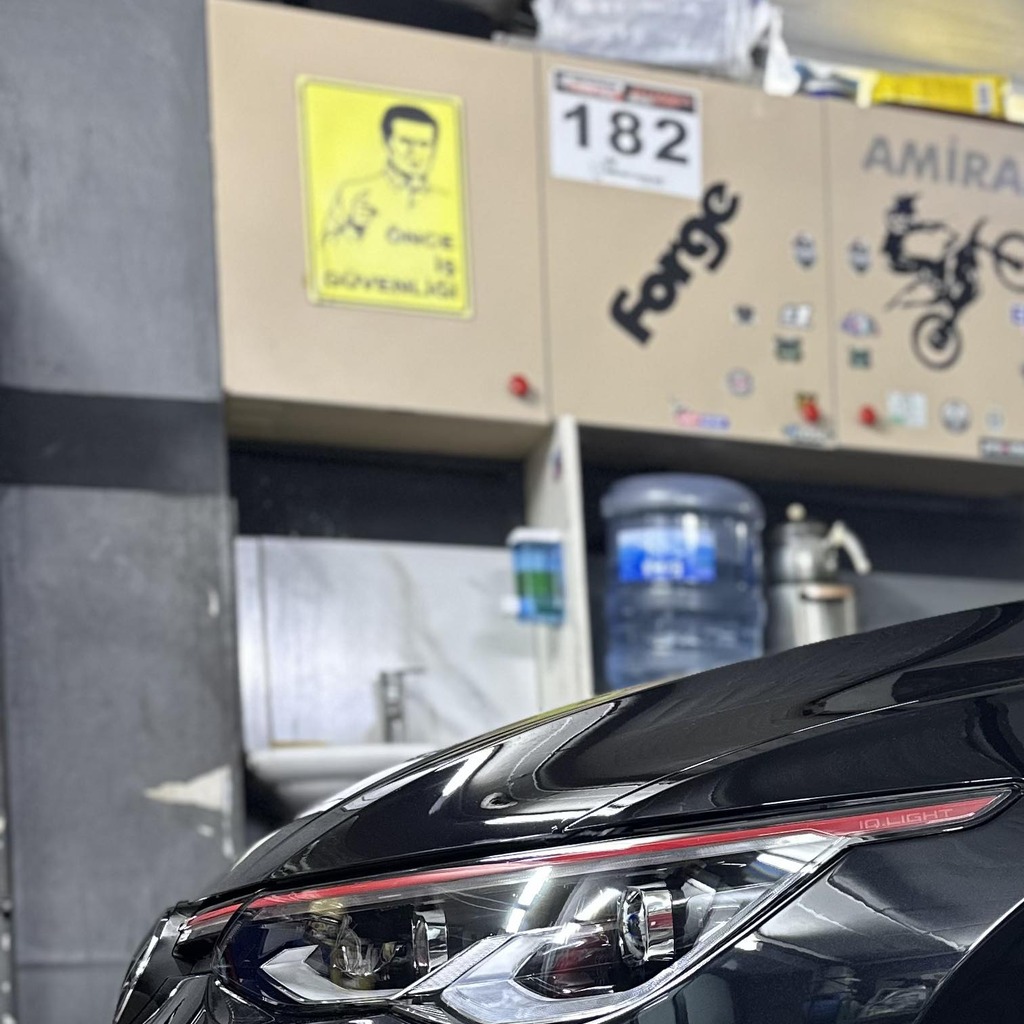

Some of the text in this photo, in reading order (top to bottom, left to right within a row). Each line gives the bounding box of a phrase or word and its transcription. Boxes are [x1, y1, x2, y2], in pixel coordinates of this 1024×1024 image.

[564, 102, 688, 164] 182
[609, 181, 741, 345] forge
[859, 808, 953, 829] IQ.LIGHT
